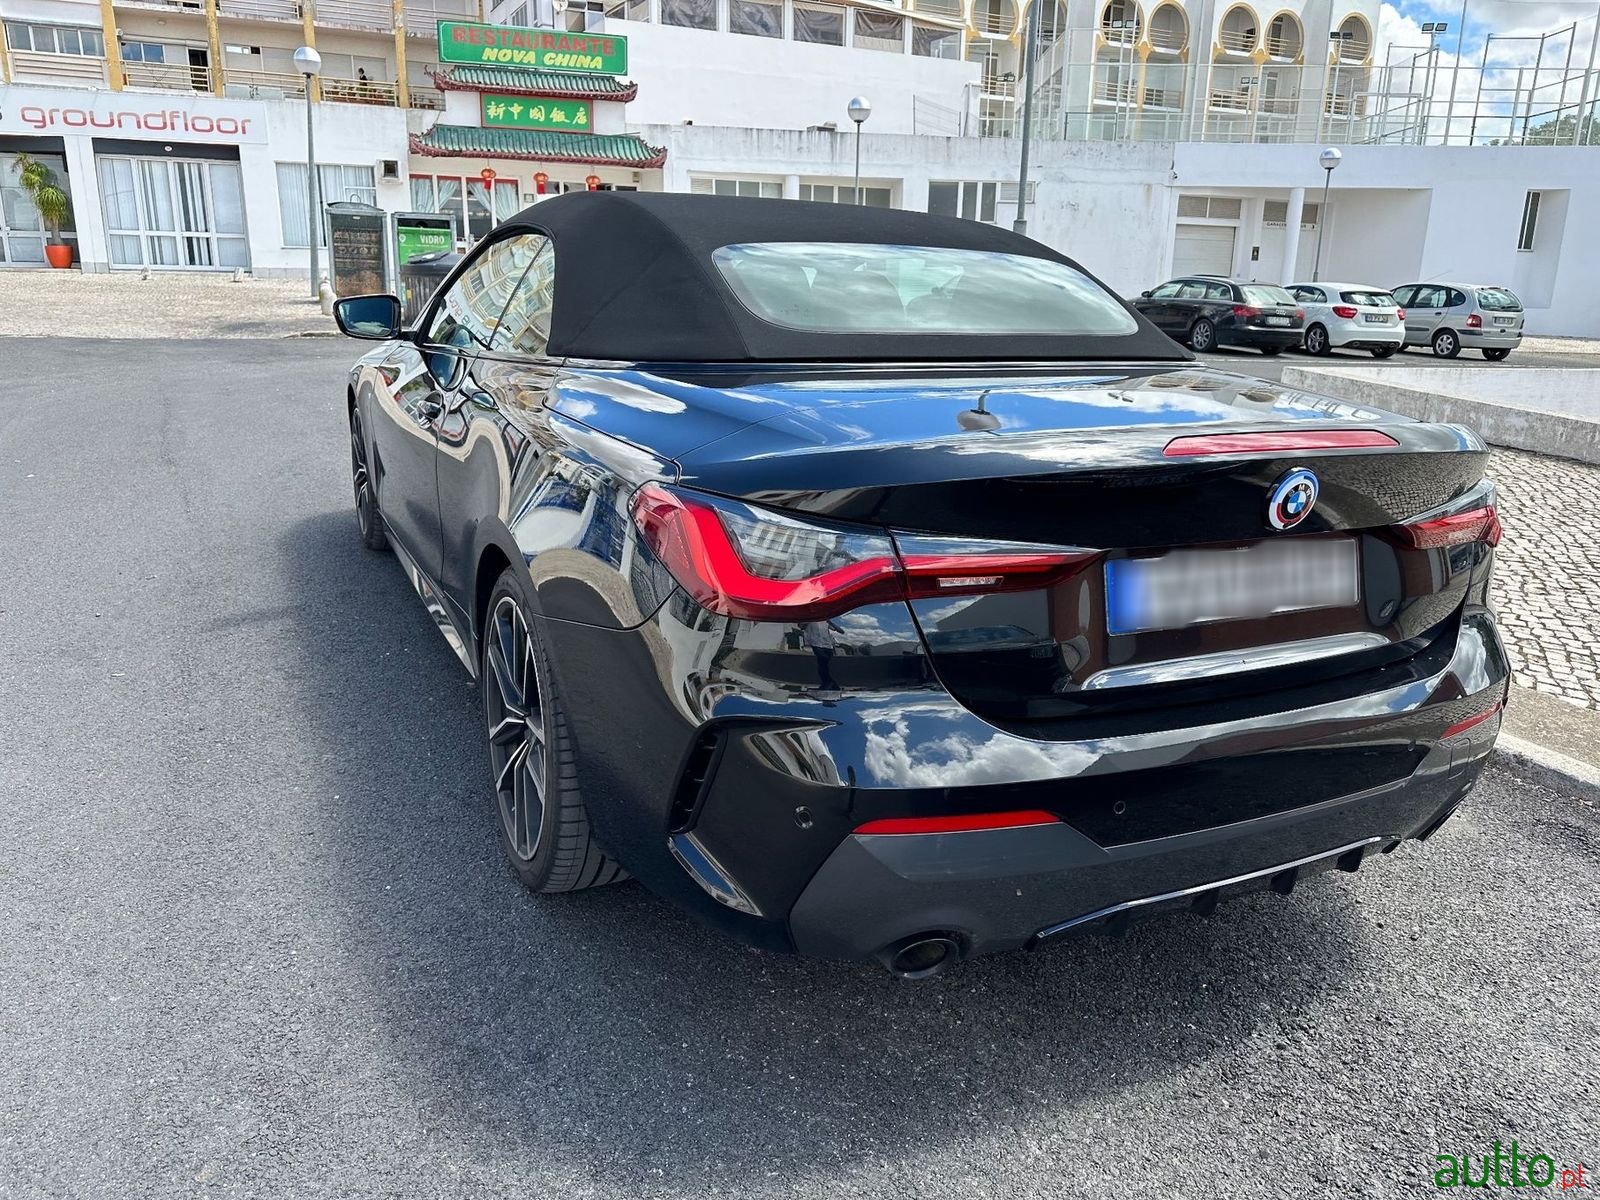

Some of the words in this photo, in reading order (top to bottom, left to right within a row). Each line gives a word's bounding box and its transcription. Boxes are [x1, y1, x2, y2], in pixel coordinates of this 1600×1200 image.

[452, 27, 615, 56] RESTAURANTE
[482, 47, 536, 63] NOVA
[543, 52, 603, 69] CHINA
[20, 106, 252, 135] groundfloor
